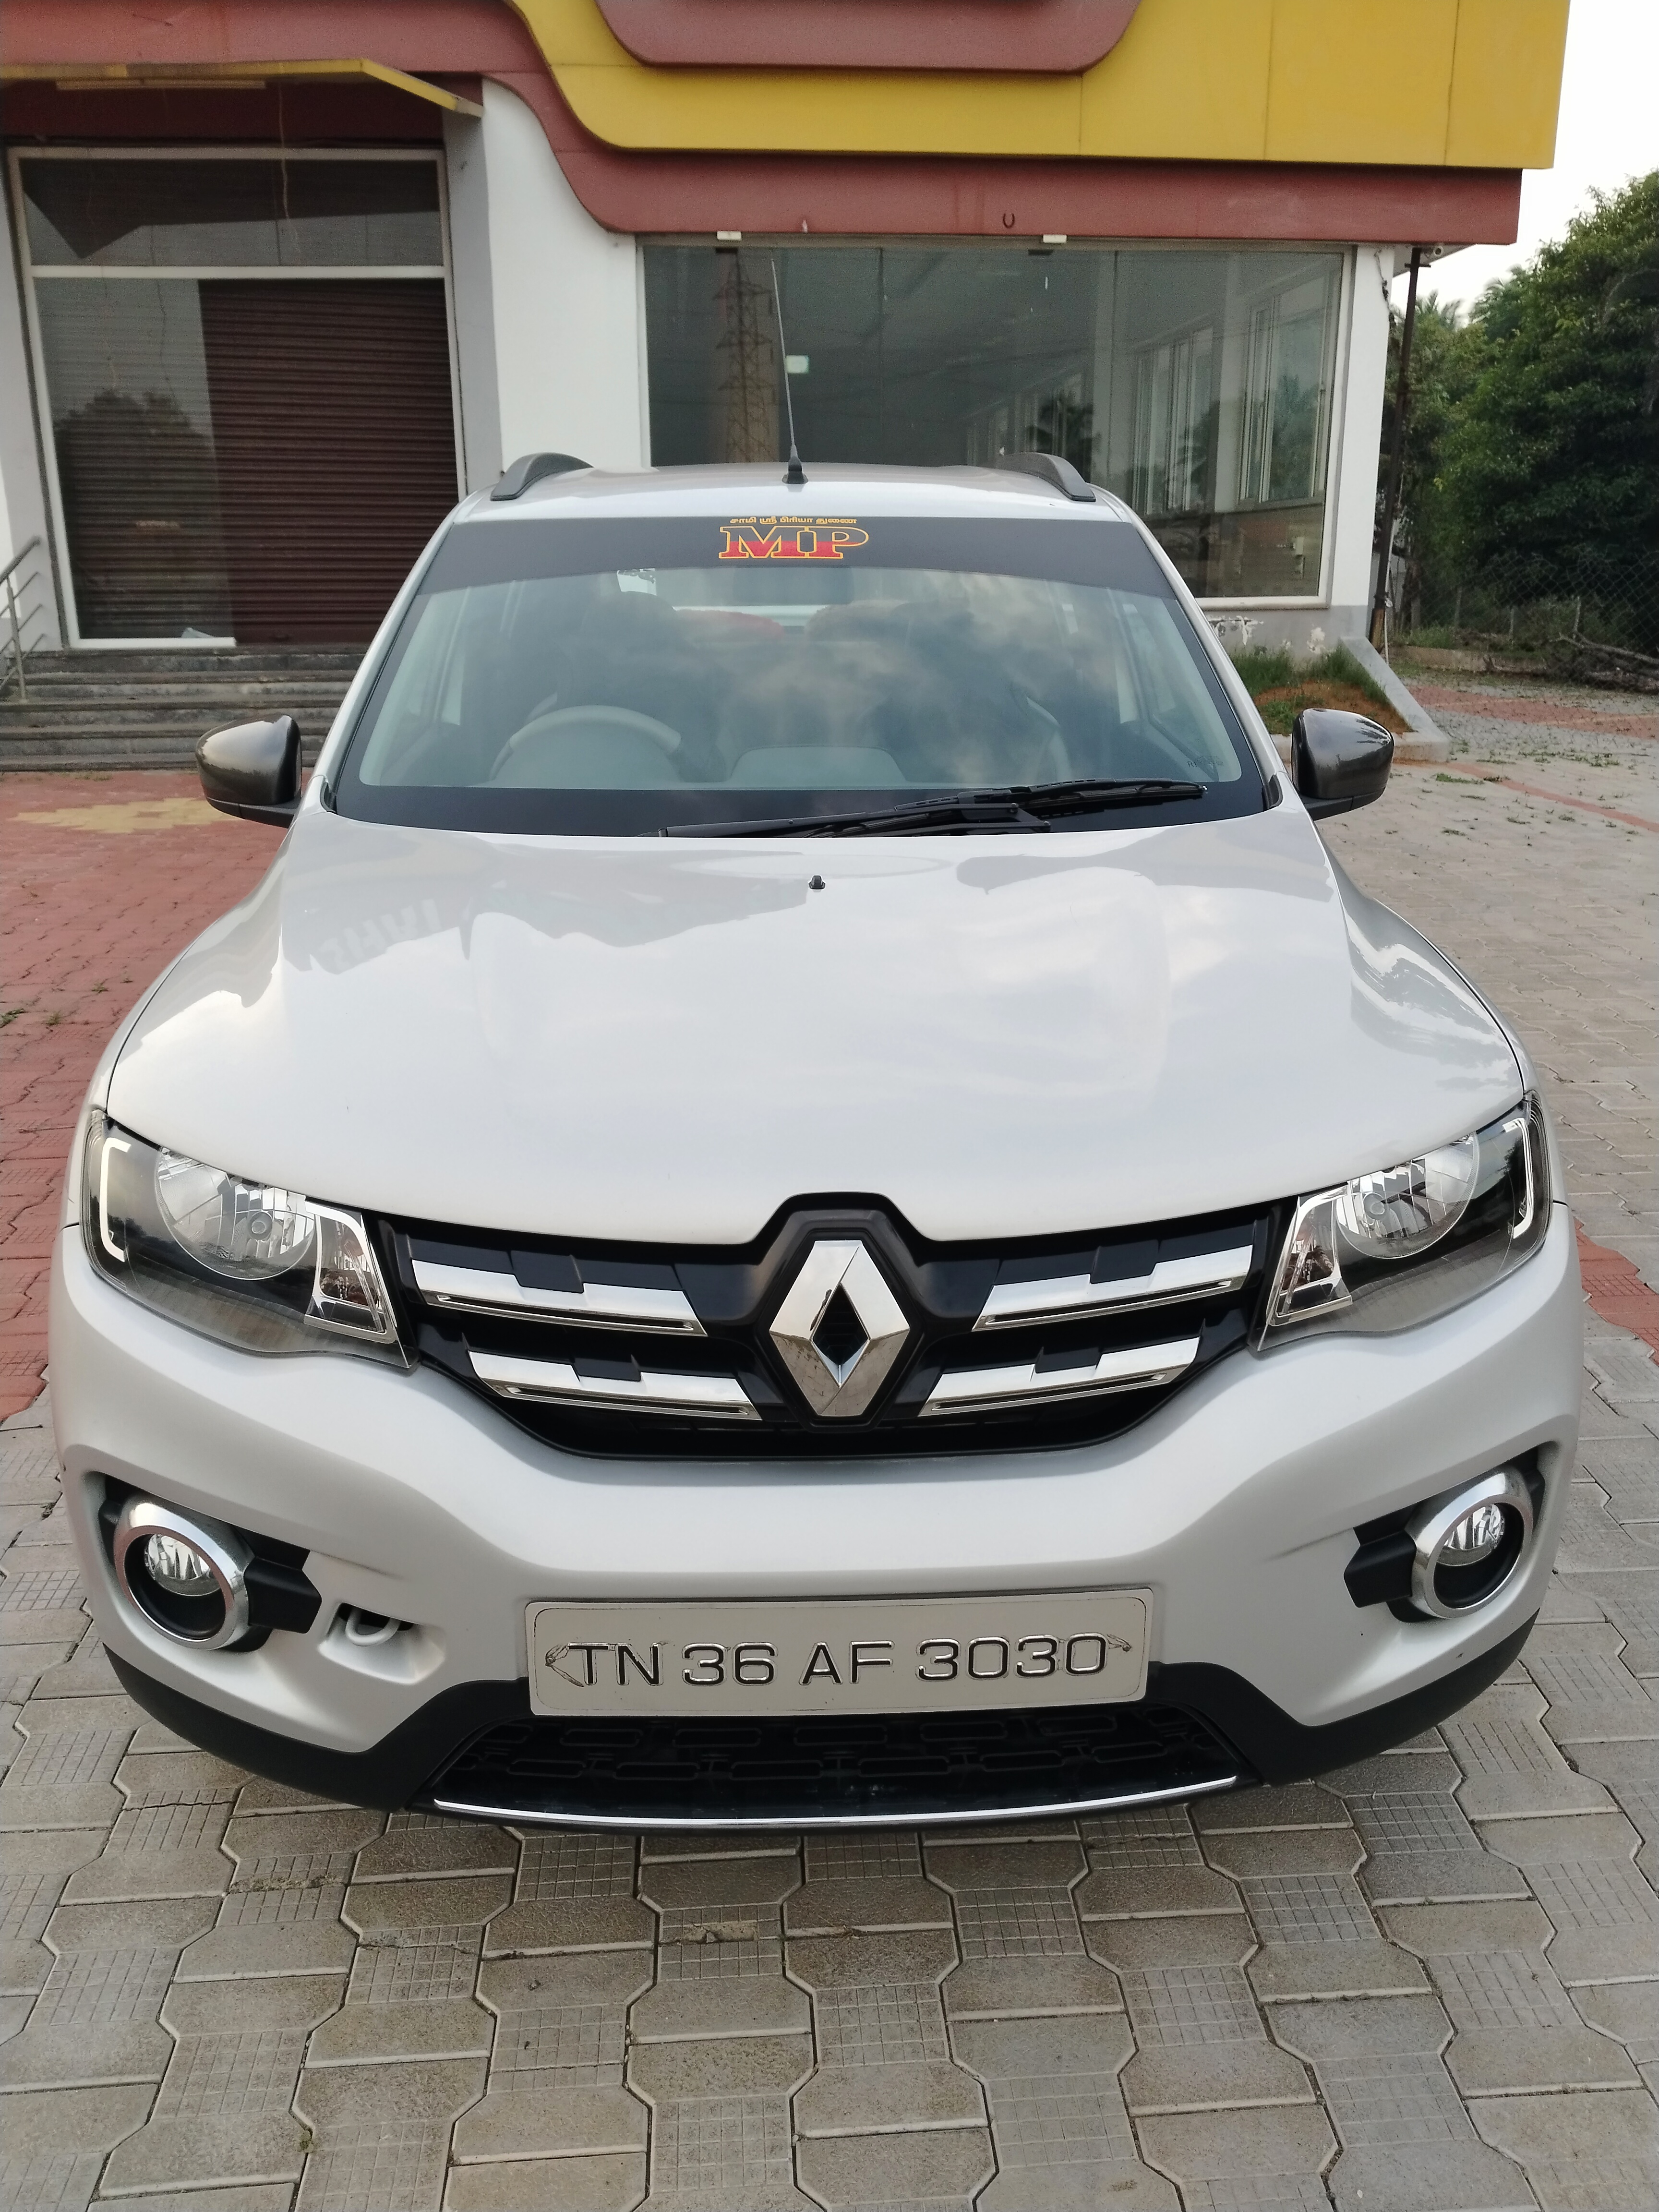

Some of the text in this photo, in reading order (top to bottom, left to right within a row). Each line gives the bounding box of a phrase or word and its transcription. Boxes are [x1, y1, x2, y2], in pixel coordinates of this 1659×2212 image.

[719, 526, 869, 559] MP
[567, 1633, 1109, 1686] TN 36 AF 3030
